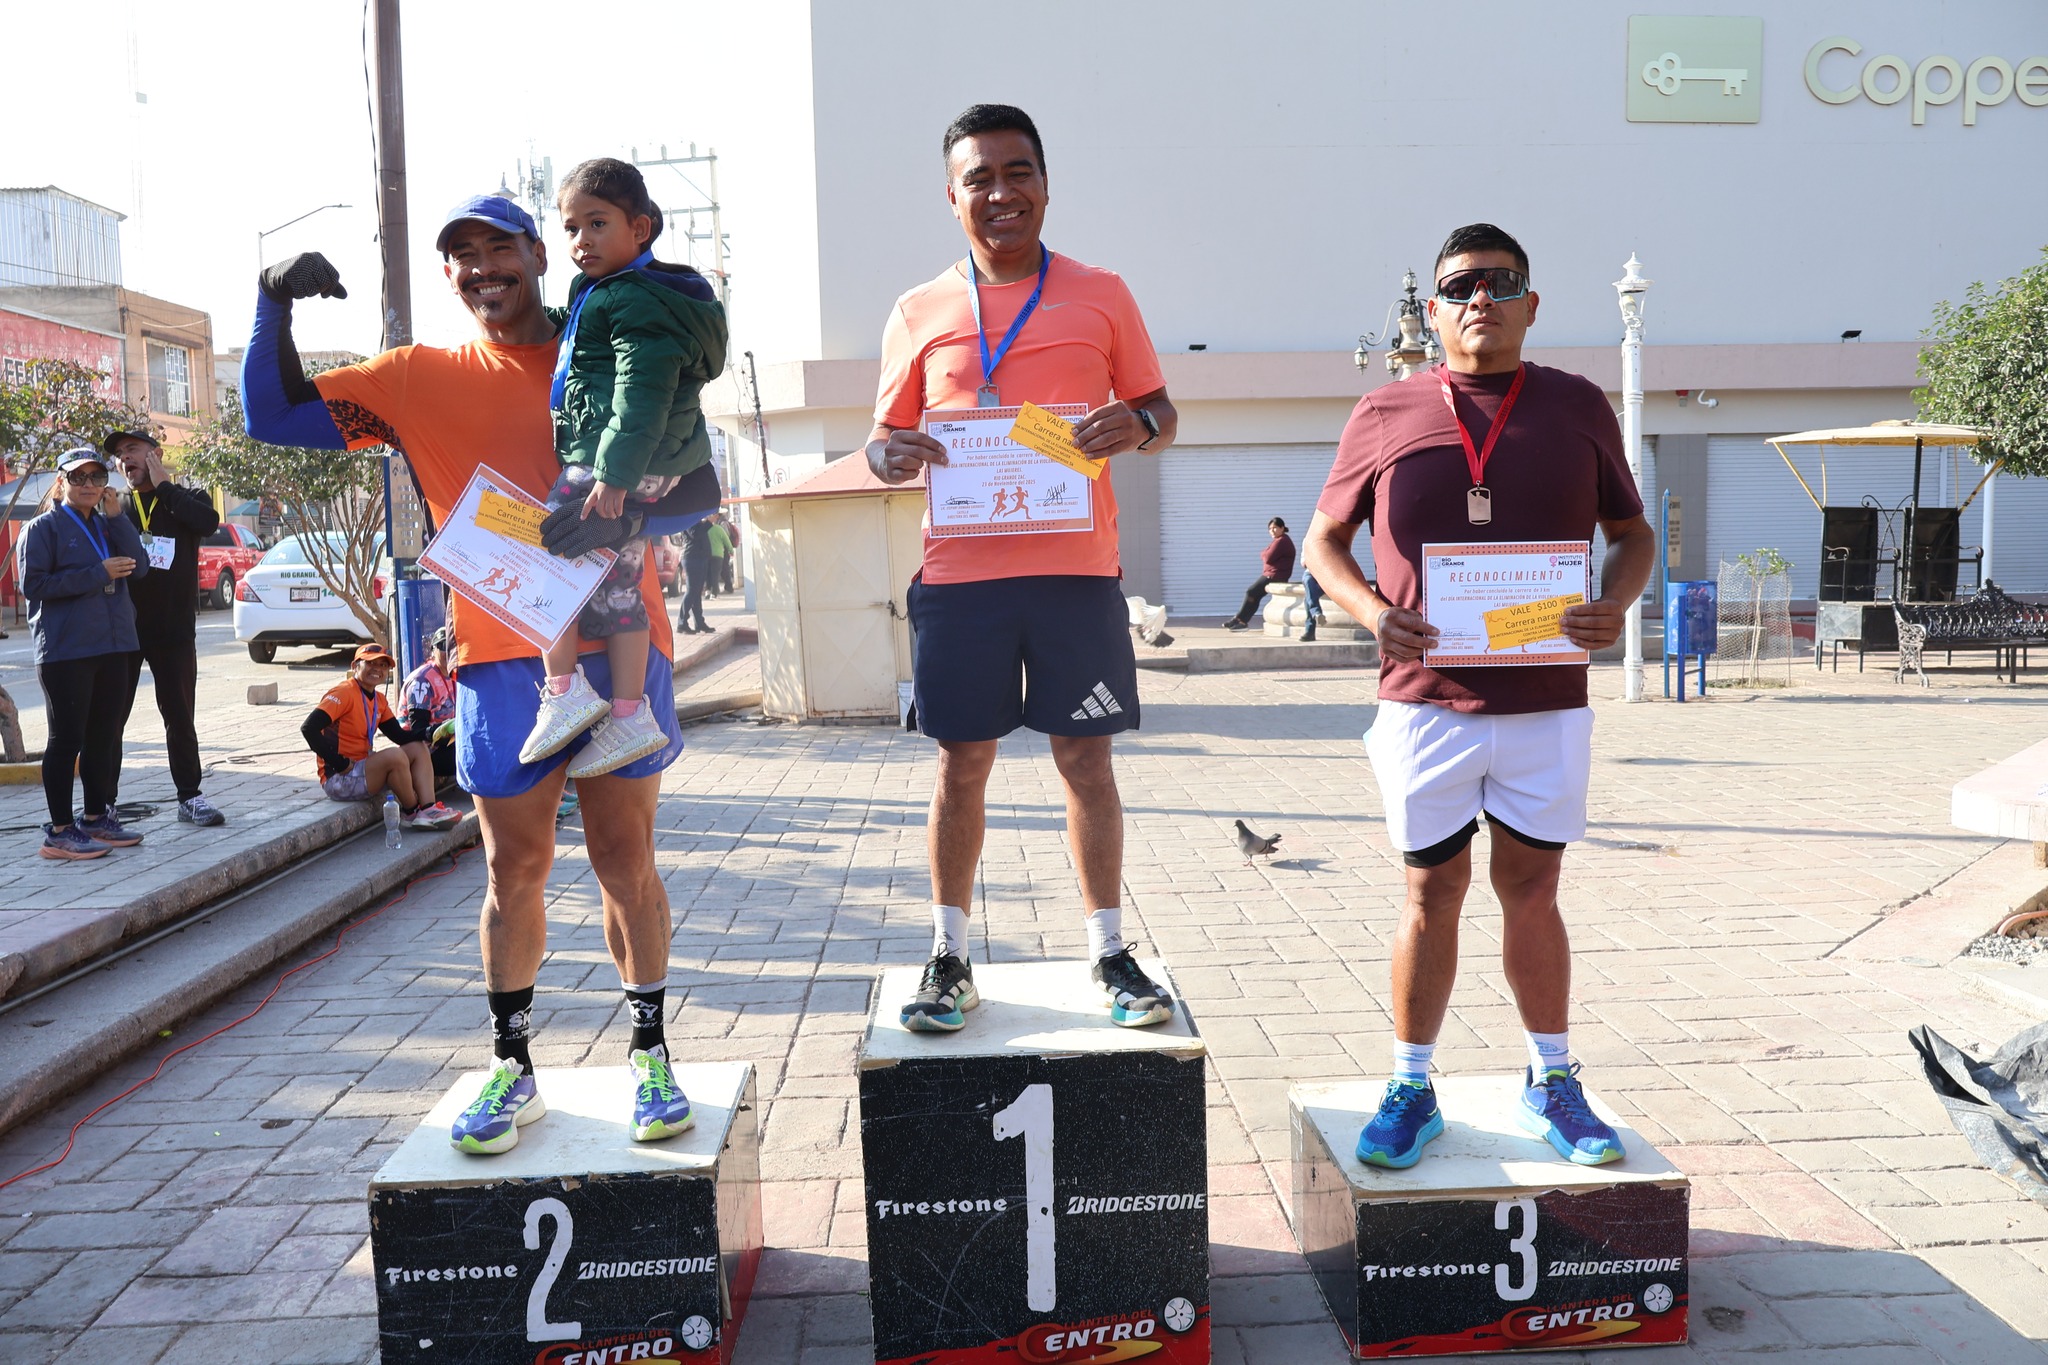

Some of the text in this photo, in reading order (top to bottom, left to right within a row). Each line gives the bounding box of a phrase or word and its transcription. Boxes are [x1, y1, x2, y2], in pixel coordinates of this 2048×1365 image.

[1045, 414, 1065, 429] VALE
[1033, 422, 1061, 441] Carrera
[496, 508, 526, 523] Carrera
[506, 500, 527, 513] VALE
[1450, 570, 1563, 582] RECONOCIMIENTO
[1509, 599, 1557, 616] VALE $100
[1504, 616, 1535, 629] Carrera
[875, 1194, 1205, 1219] Firestone BRIDGESTONE
[993, 1083, 1055, 1312] 1
[1494, 1199, 1538, 1301] 3
[385, 1256, 716, 1286] Firestone BRIDGESTONE
[523, 1198, 581, 1342] 2
[1363, 1257, 1682, 1281] Firestone BRIDGESTONE
[1546, 1299, 1608, 1312] LLANTERA
[1064, 1309, 1154, 1329] LLANTERA DEL
[582, 1332, 644, 1350] LLANTERA
